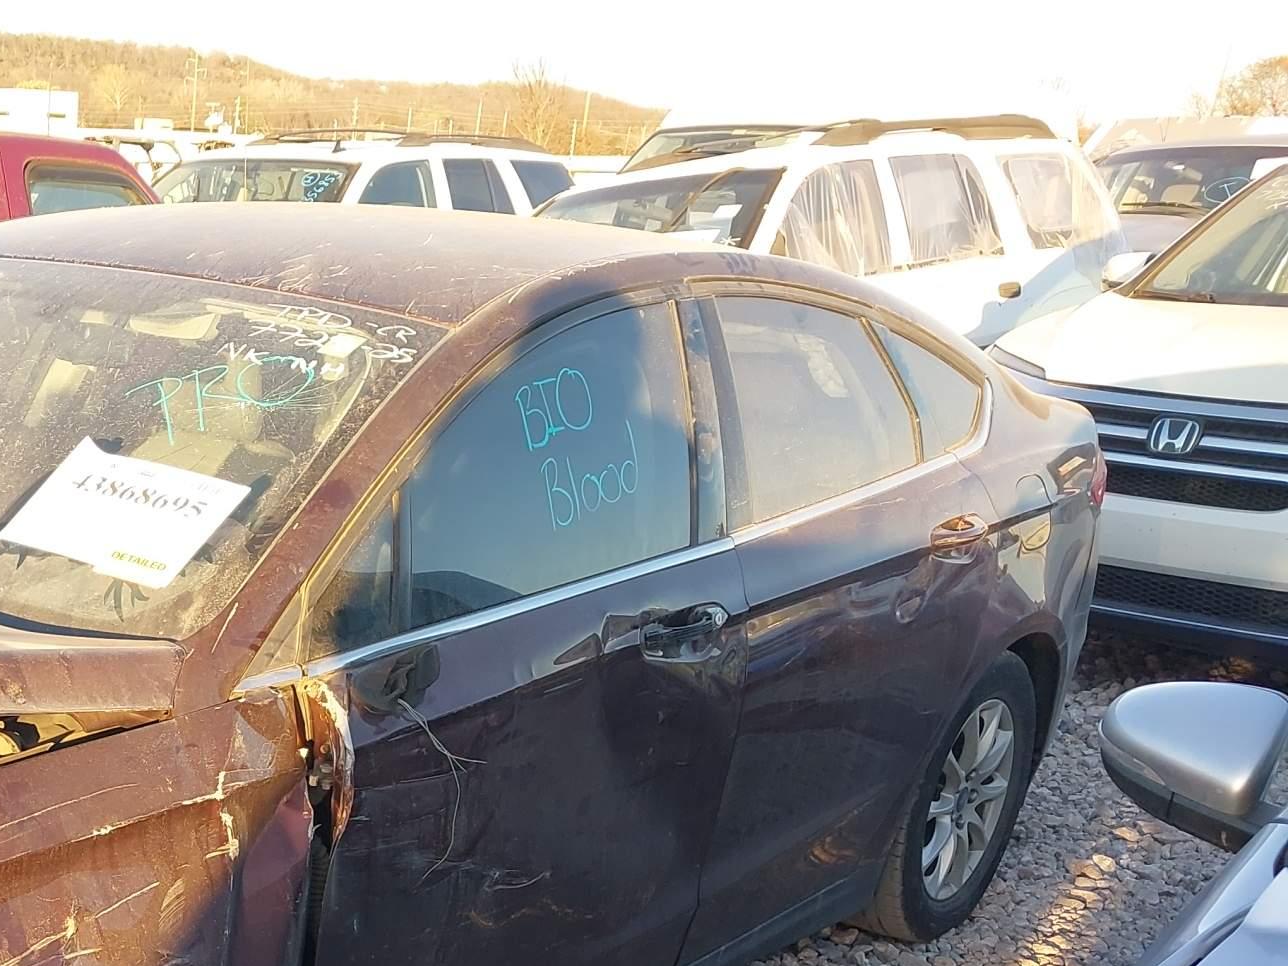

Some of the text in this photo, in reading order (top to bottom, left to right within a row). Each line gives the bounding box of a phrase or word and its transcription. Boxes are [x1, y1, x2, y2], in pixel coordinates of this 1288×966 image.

[124, 354, 315, 447] PRO
[515, 368, 593, 451] BIO
[72, 473, 208, 517] 43868695
[540, 418, 639, 531] Blood
[111, 551, 167, 572] DETAILED
